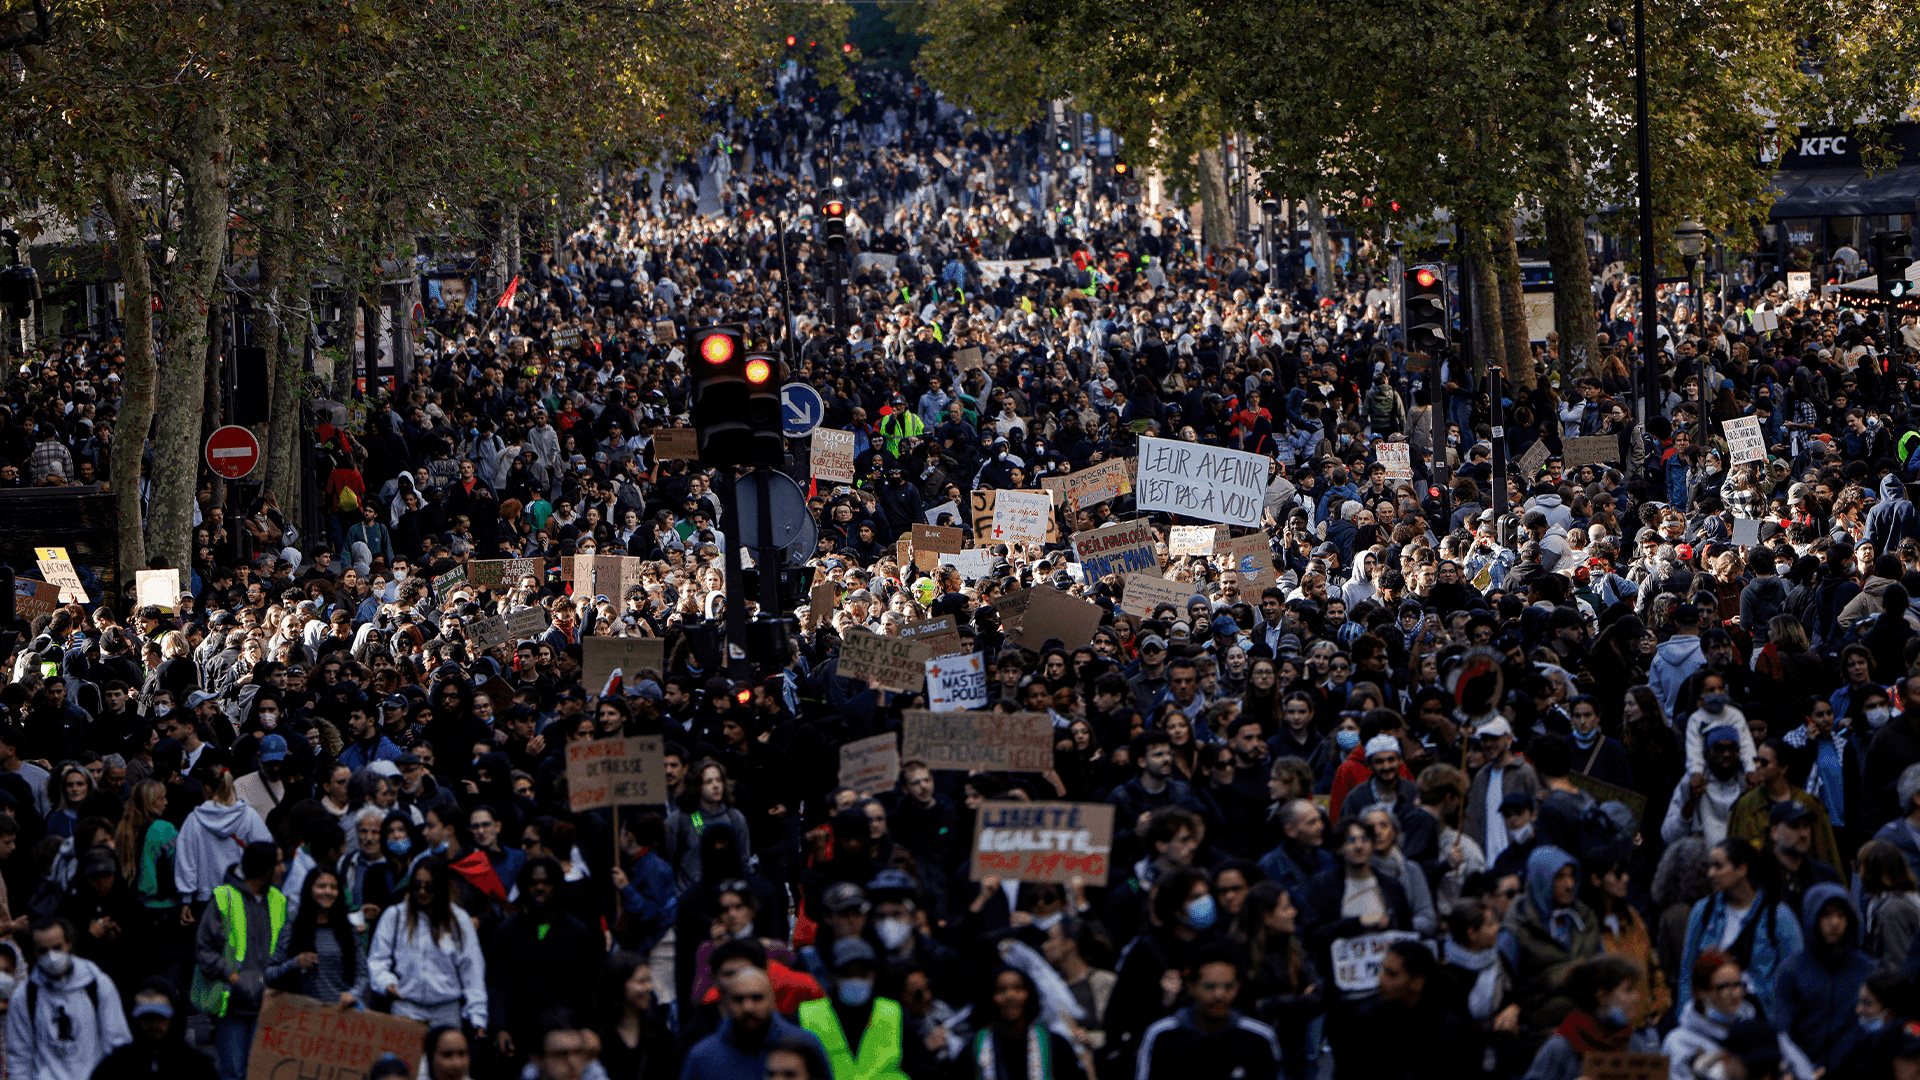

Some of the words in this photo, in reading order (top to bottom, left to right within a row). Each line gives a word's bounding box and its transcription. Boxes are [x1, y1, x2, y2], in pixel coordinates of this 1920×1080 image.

[1799, 136, 1847, 156] KFC
[1788, 231, 1814, 242] SAUCY
[1145, 443, 1189, 479] LEUR
[1196, 452, 1263, 497] AVENIR
[1174, 484, 1200, 510] PAS
[1200, 481, 1216, 513] À
[1220, 489, 1258, 524] VOUS
[1102, 532, 1129, 549] POUR
[1123, 545, 1156, 572] MAIN
[901, 627, 916, 637] ON
[844, 632, 860, 647] UN
[891, 642, 911, 659] QUI
